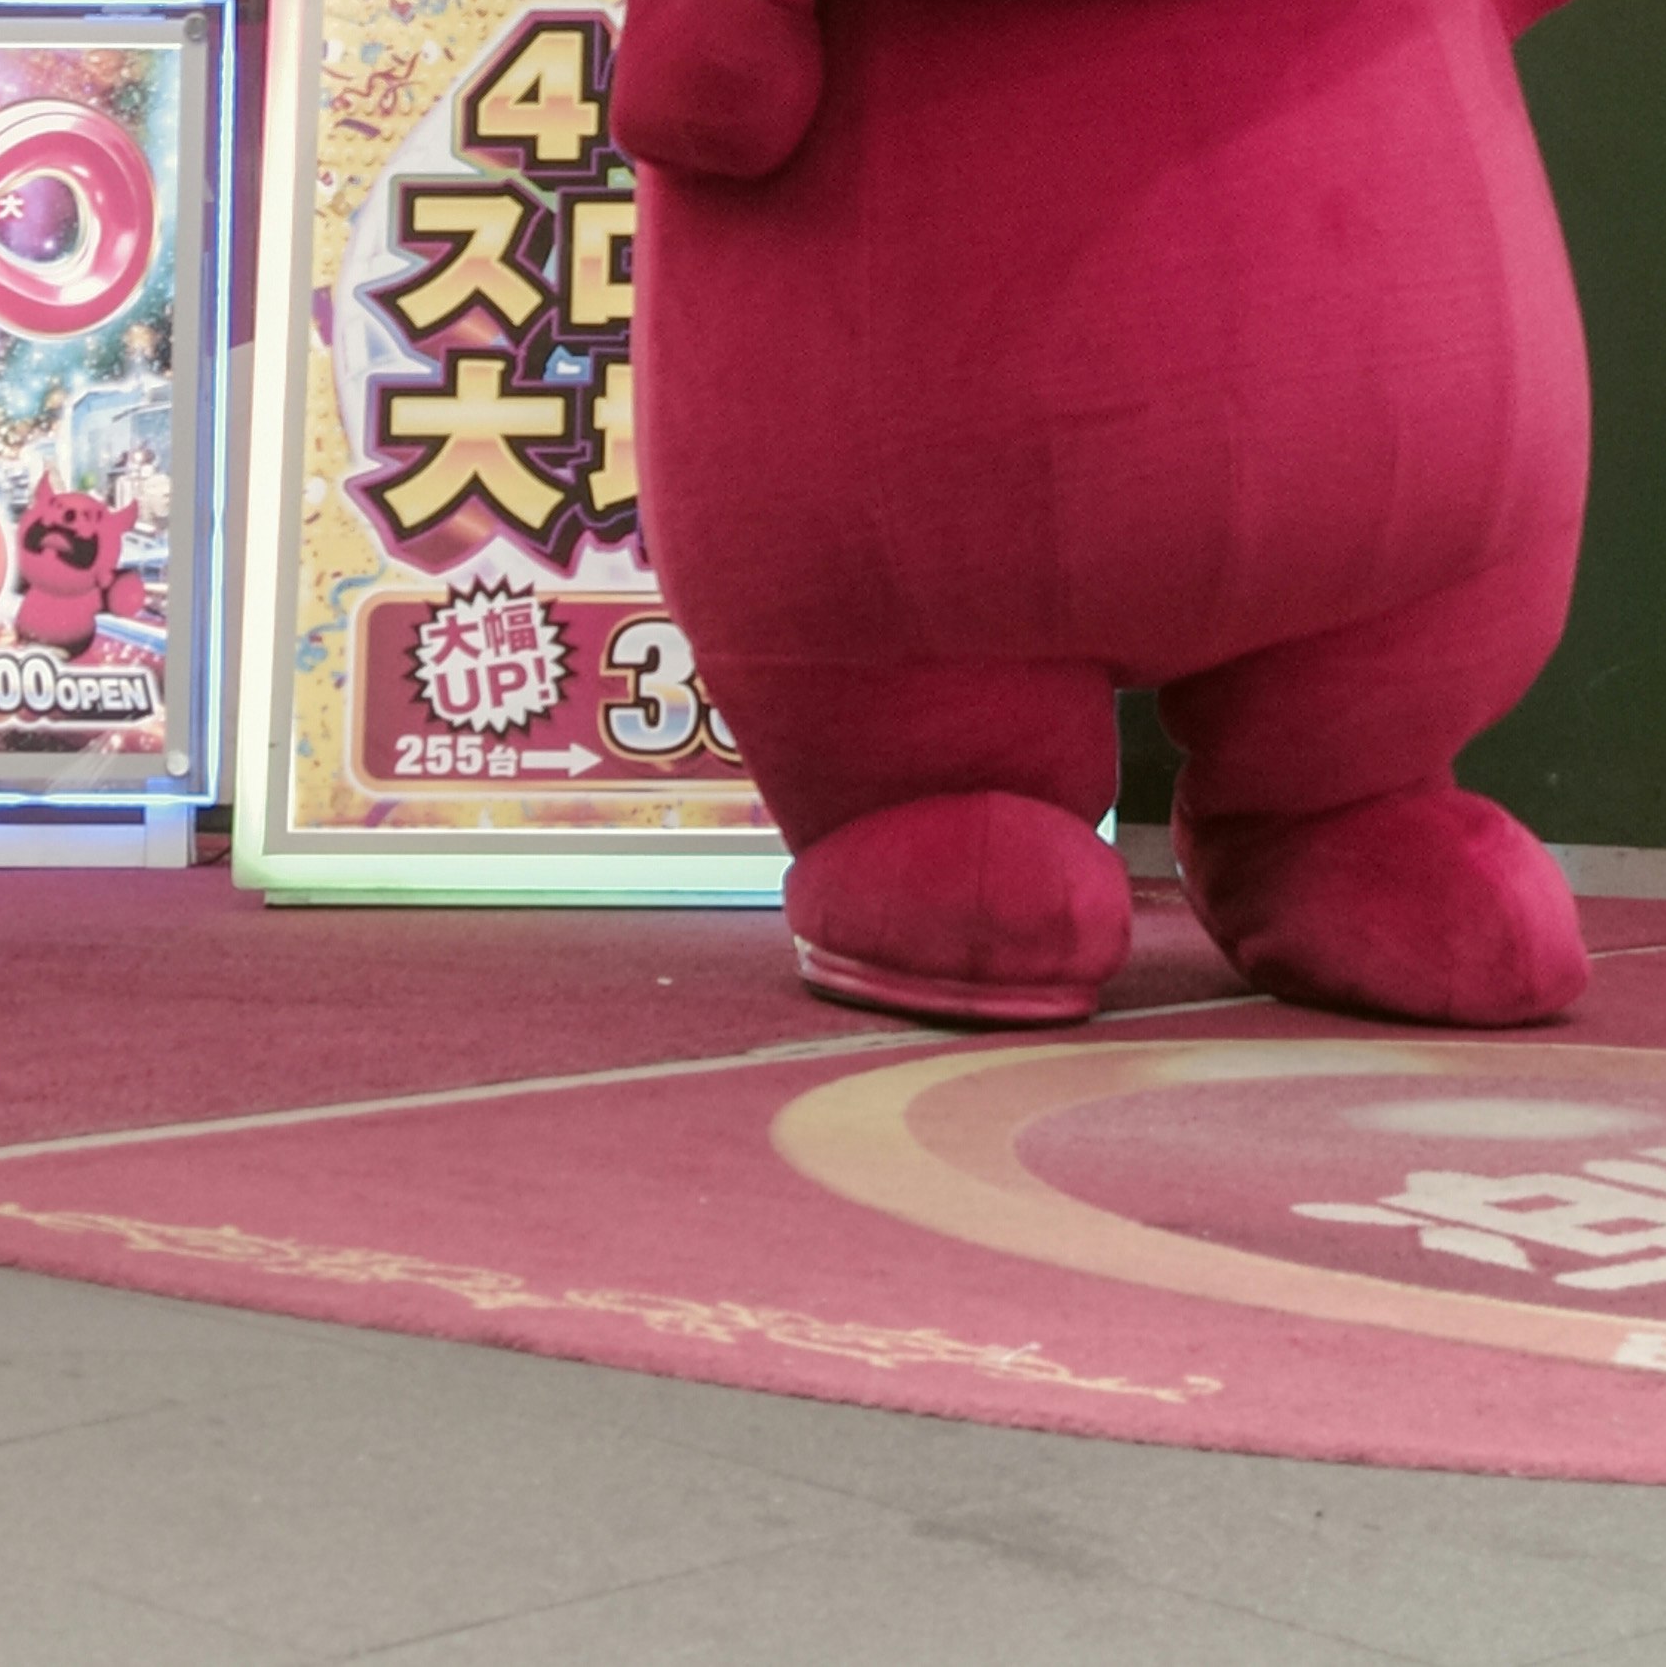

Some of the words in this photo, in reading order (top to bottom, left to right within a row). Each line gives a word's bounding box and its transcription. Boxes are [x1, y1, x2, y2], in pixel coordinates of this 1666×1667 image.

[431, 603, 539, 668] 大幅
[55, 677, 149, 710] OPEN
[435, 656, 552, 717] UP!
[394, 734, 523, 779] 255台
